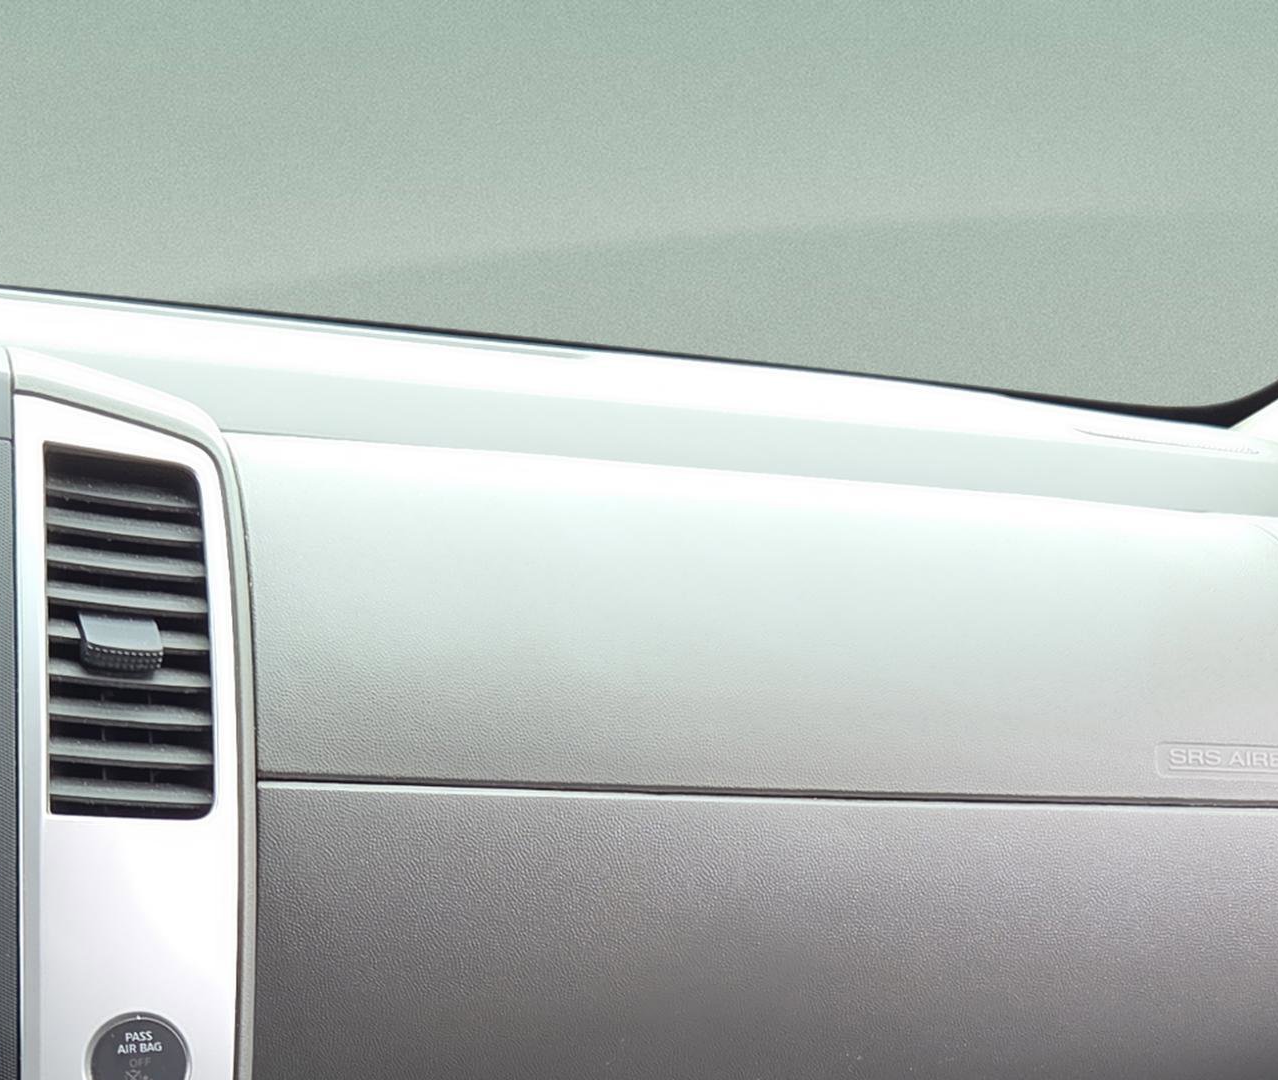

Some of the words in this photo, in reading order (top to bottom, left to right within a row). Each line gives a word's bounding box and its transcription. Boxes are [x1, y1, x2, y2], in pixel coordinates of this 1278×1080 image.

[1169, 748, 1222, 766] SRS
[125, 1031, 153, 1042] PASS
[117, 1043, 137, 1055] AIR
[139, 1042, 162, 1053] BAG
[129, 1057, 152, 1068] OFF
